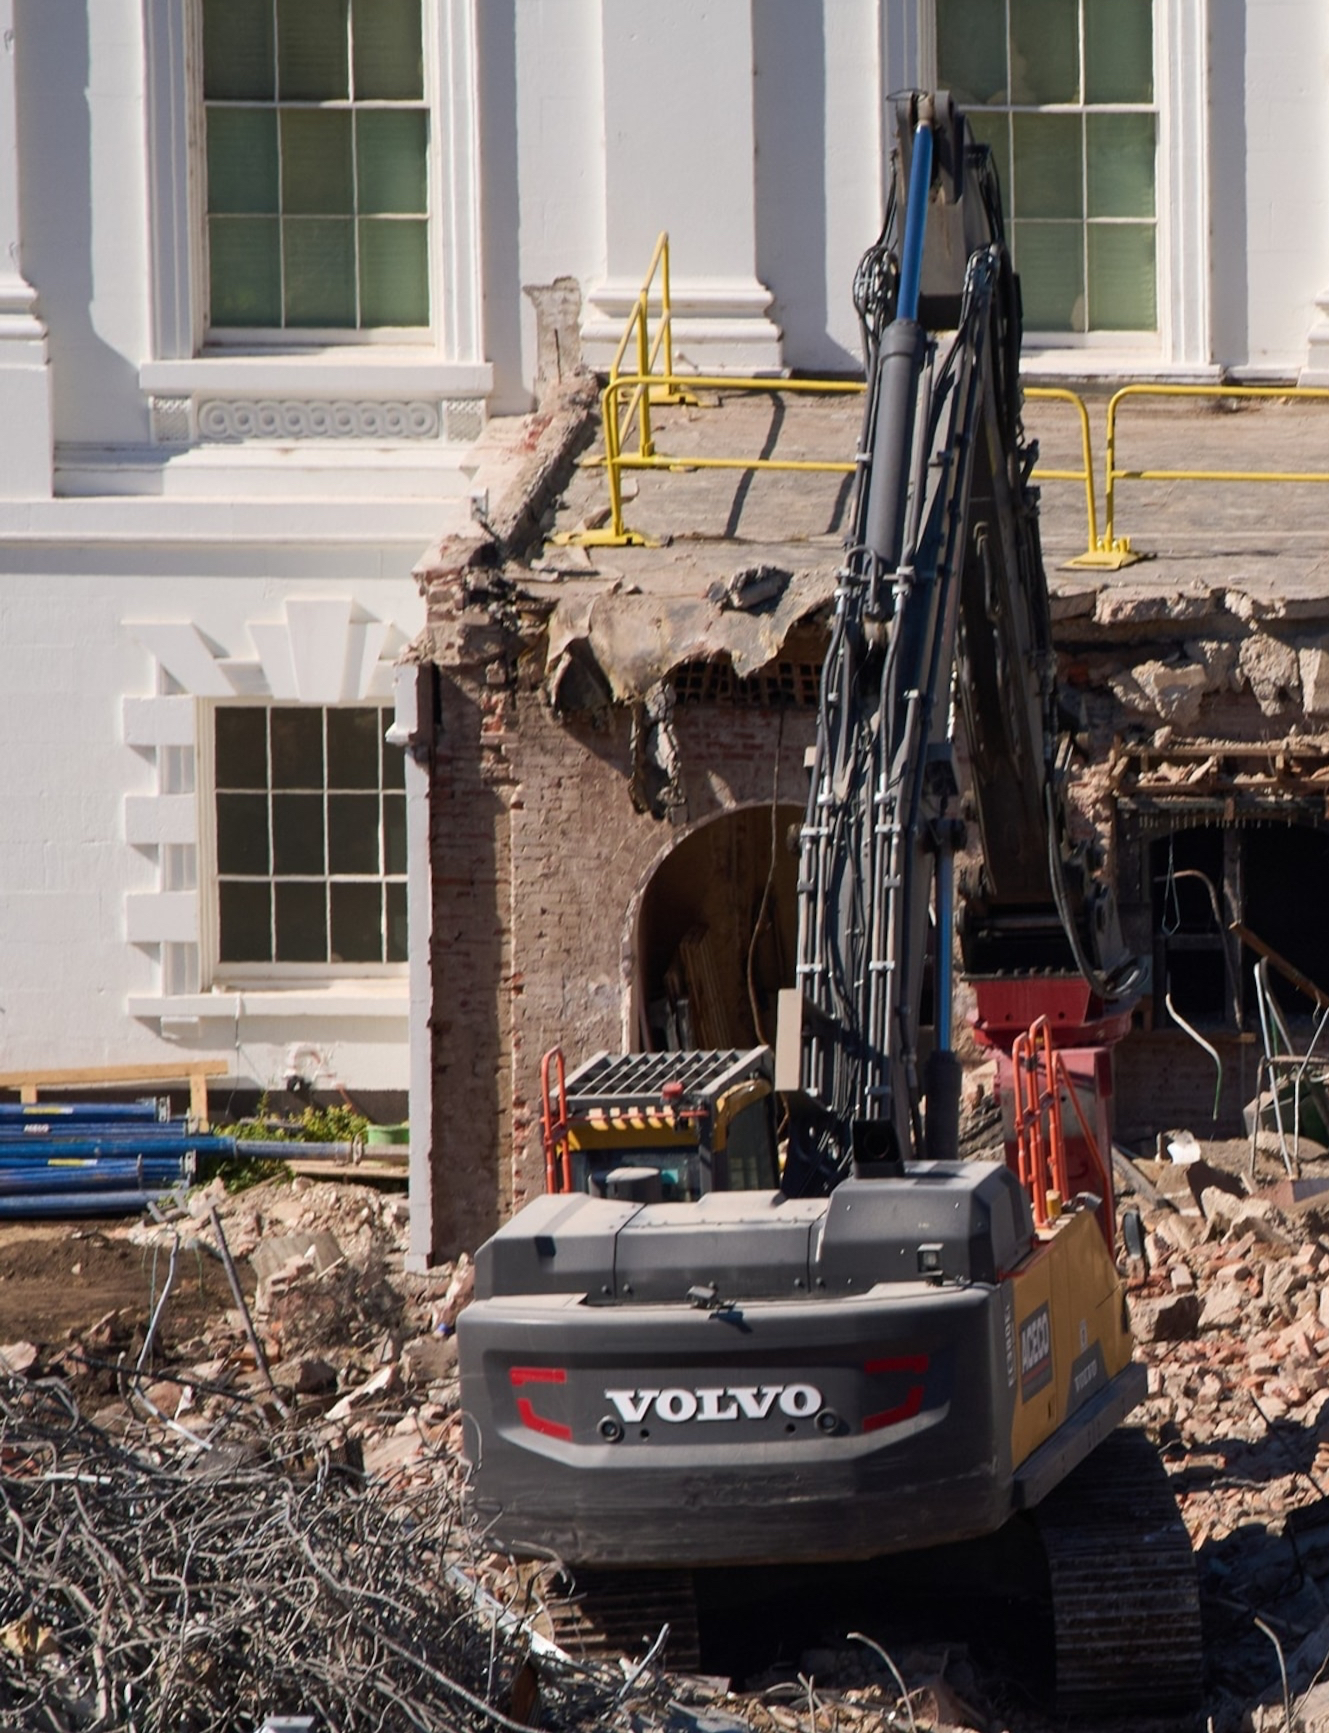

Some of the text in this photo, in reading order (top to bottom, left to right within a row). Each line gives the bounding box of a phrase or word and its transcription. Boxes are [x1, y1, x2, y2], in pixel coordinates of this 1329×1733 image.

[1021, 1310, 1050, 1376] ACECO
[1073, 1358, 1098, 1393] VOLVO
[604, 1383, 822, 1423] VOLVO
